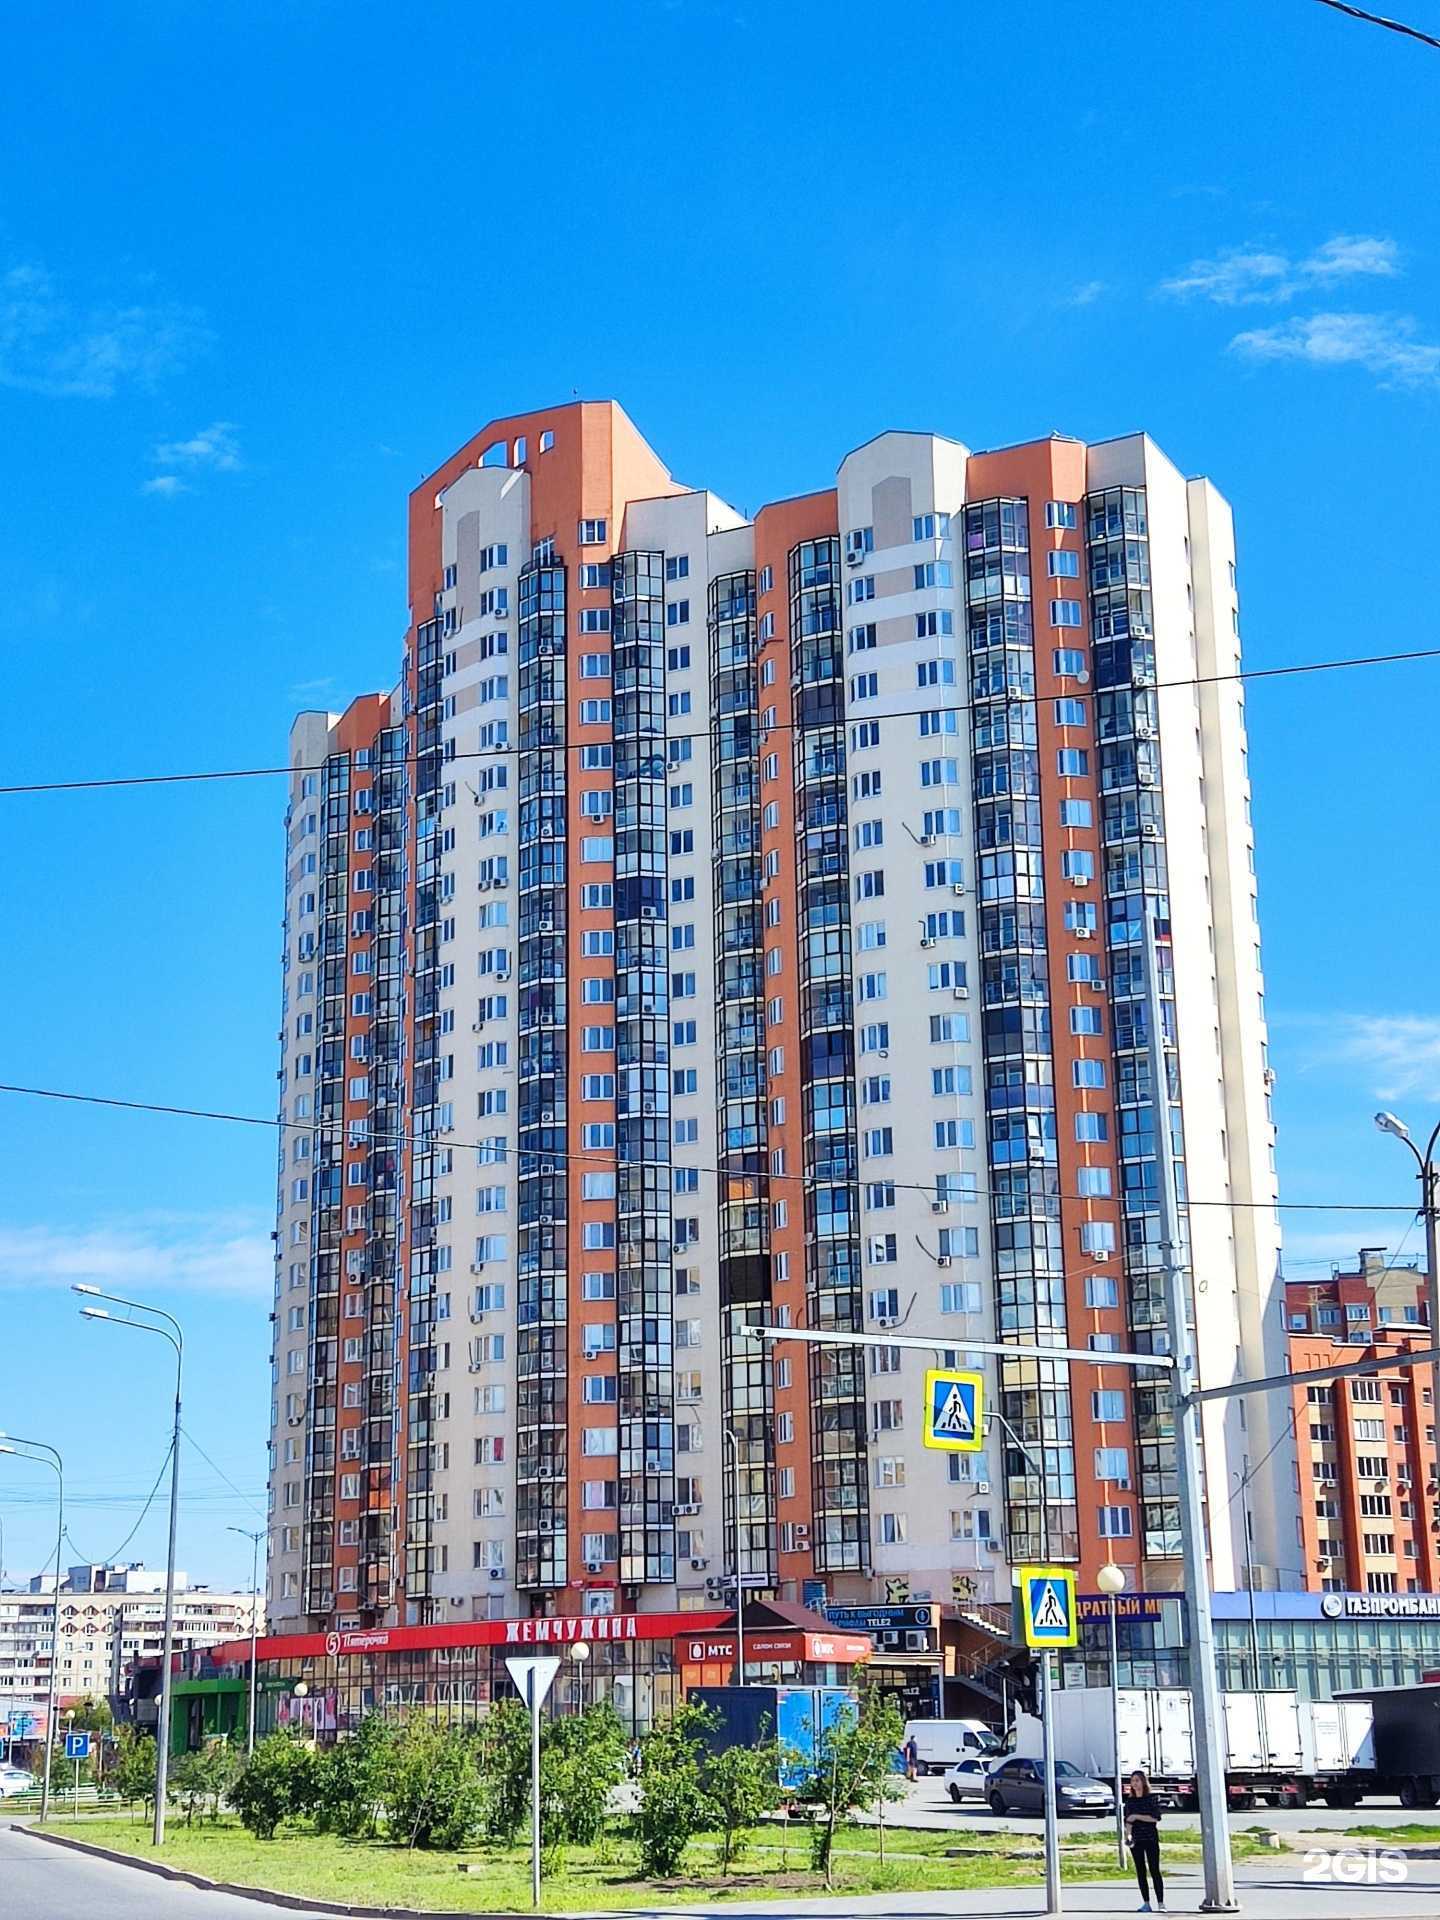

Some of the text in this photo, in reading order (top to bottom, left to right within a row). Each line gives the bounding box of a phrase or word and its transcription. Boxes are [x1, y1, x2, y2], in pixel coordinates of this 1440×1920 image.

[1346, 1597, 1440, 1615] ГАЗПРОМБАН
[506, 1617, 637, 1642] ЖЕМЧУЖИНА
[867, 1618, 891, 1627] TELE2
[708, 1645, 732, 1656] МТС
[72, 1737, 84, 1755] P
